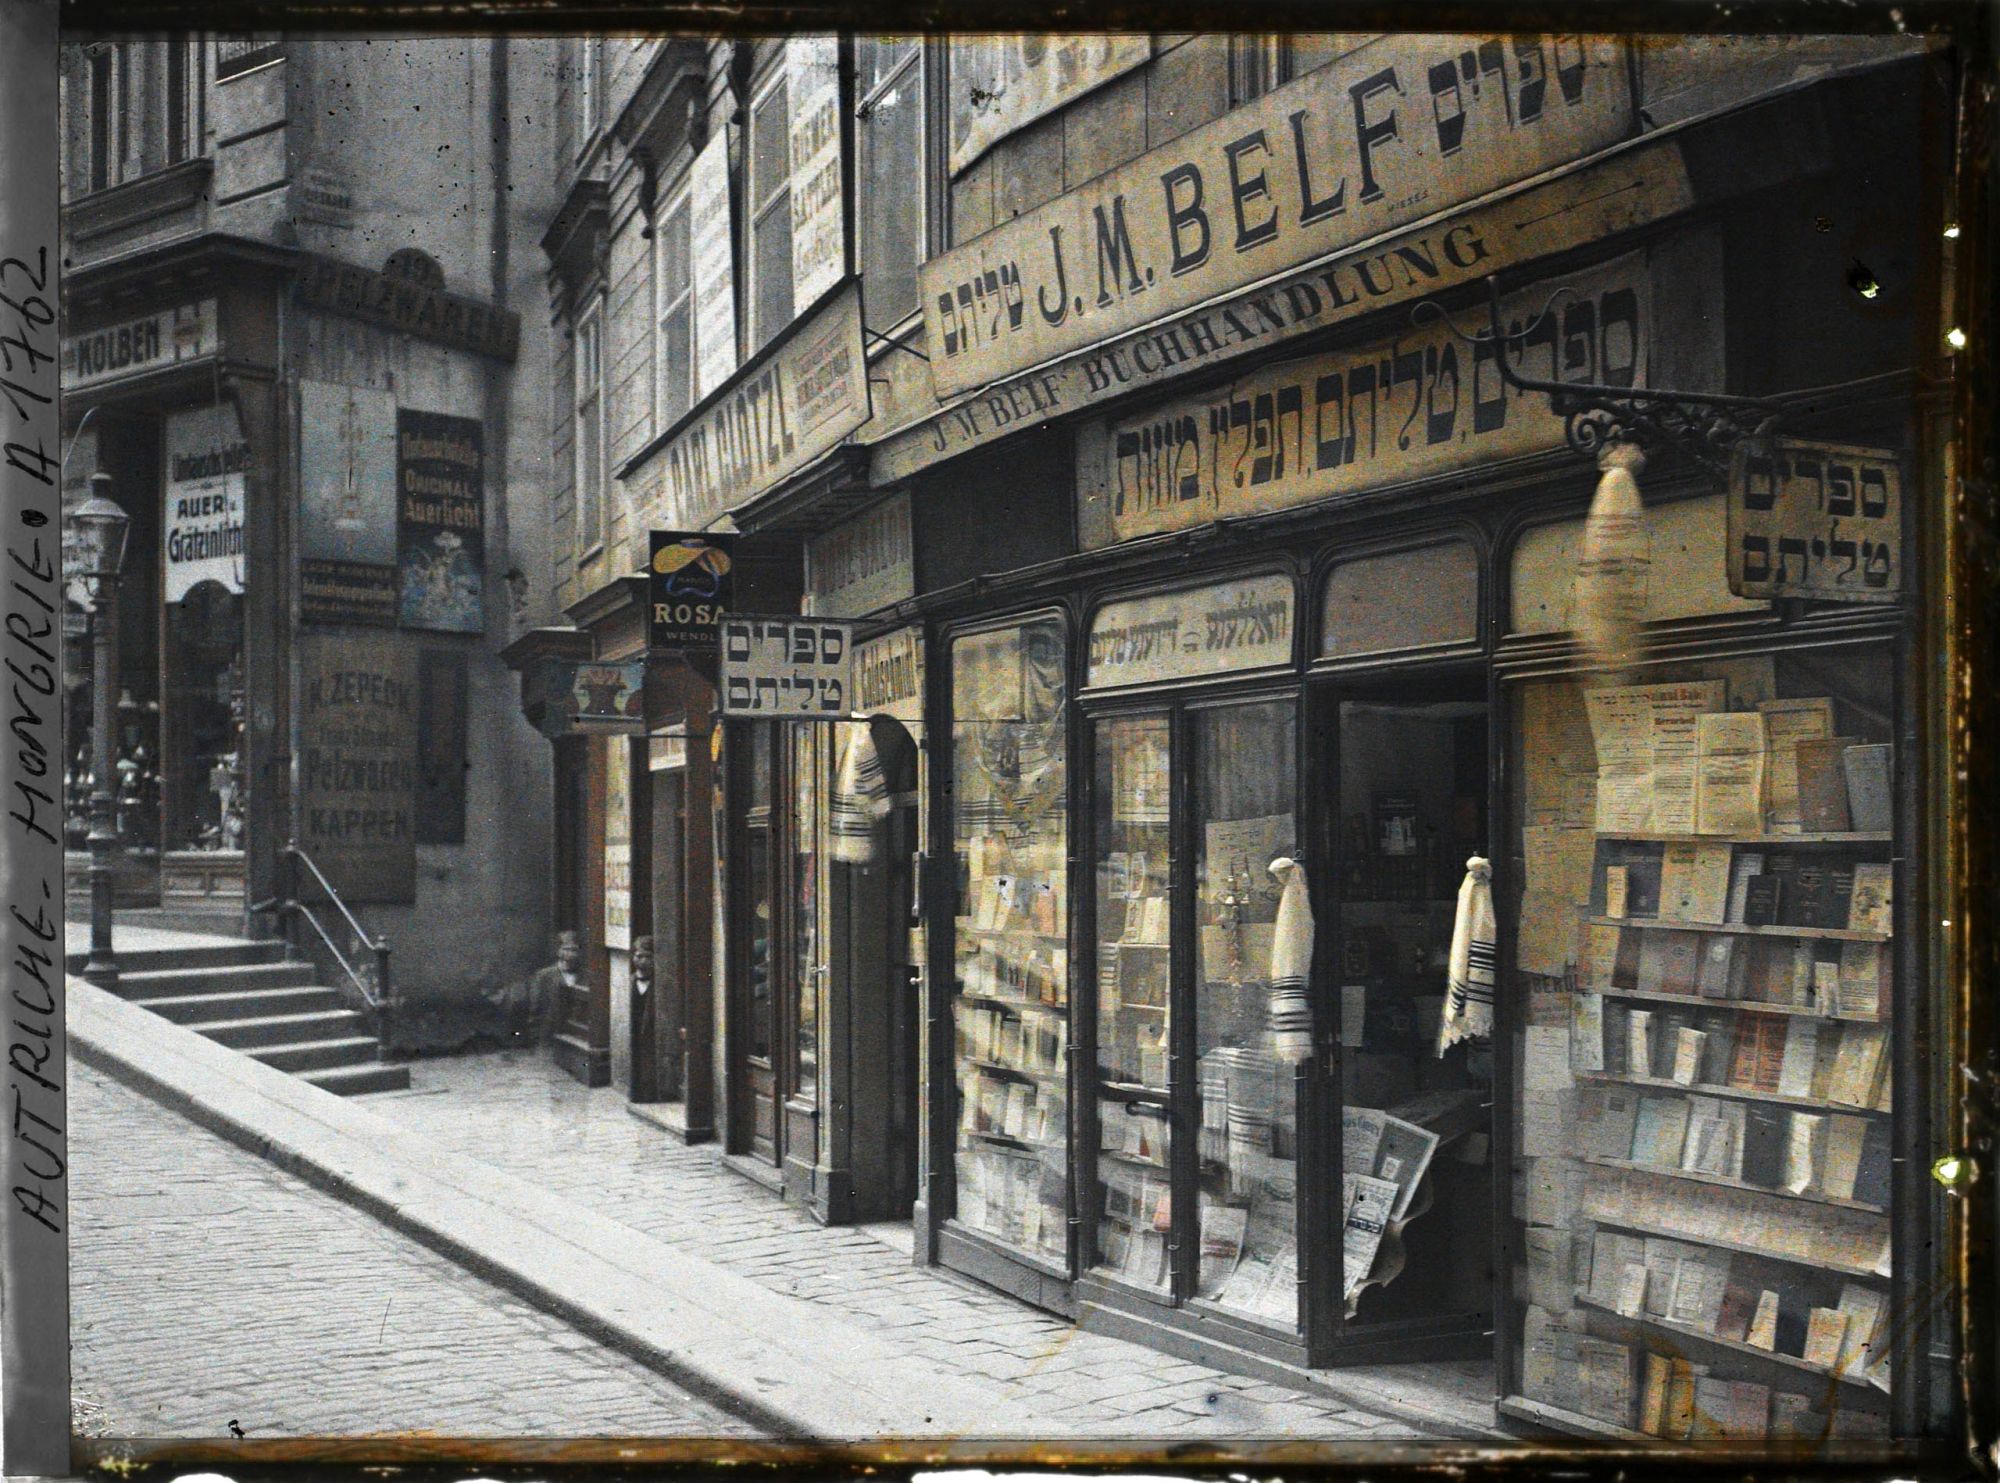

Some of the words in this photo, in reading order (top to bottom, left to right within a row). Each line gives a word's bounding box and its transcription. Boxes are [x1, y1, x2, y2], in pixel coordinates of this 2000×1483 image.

[1039, 224, 1084, 327] J.
[1093, 194, 1156, 309] M.
[1160, 66, 1407, 278] BELF
[1080, 223, 1492, 394] BUCHHANDLUNG
[78, 318, 160, 377] KOLBEN
[177, 494, 224, 519] AUER
[1744, 456, 1887, 519] ספרים
[1742, 518, 1890, 587] טליתם
[727, 625, 843, 665] ספרים
[727, 669, 843, 711] טליתם
[310, 809, 408, 839] KAPPEN
